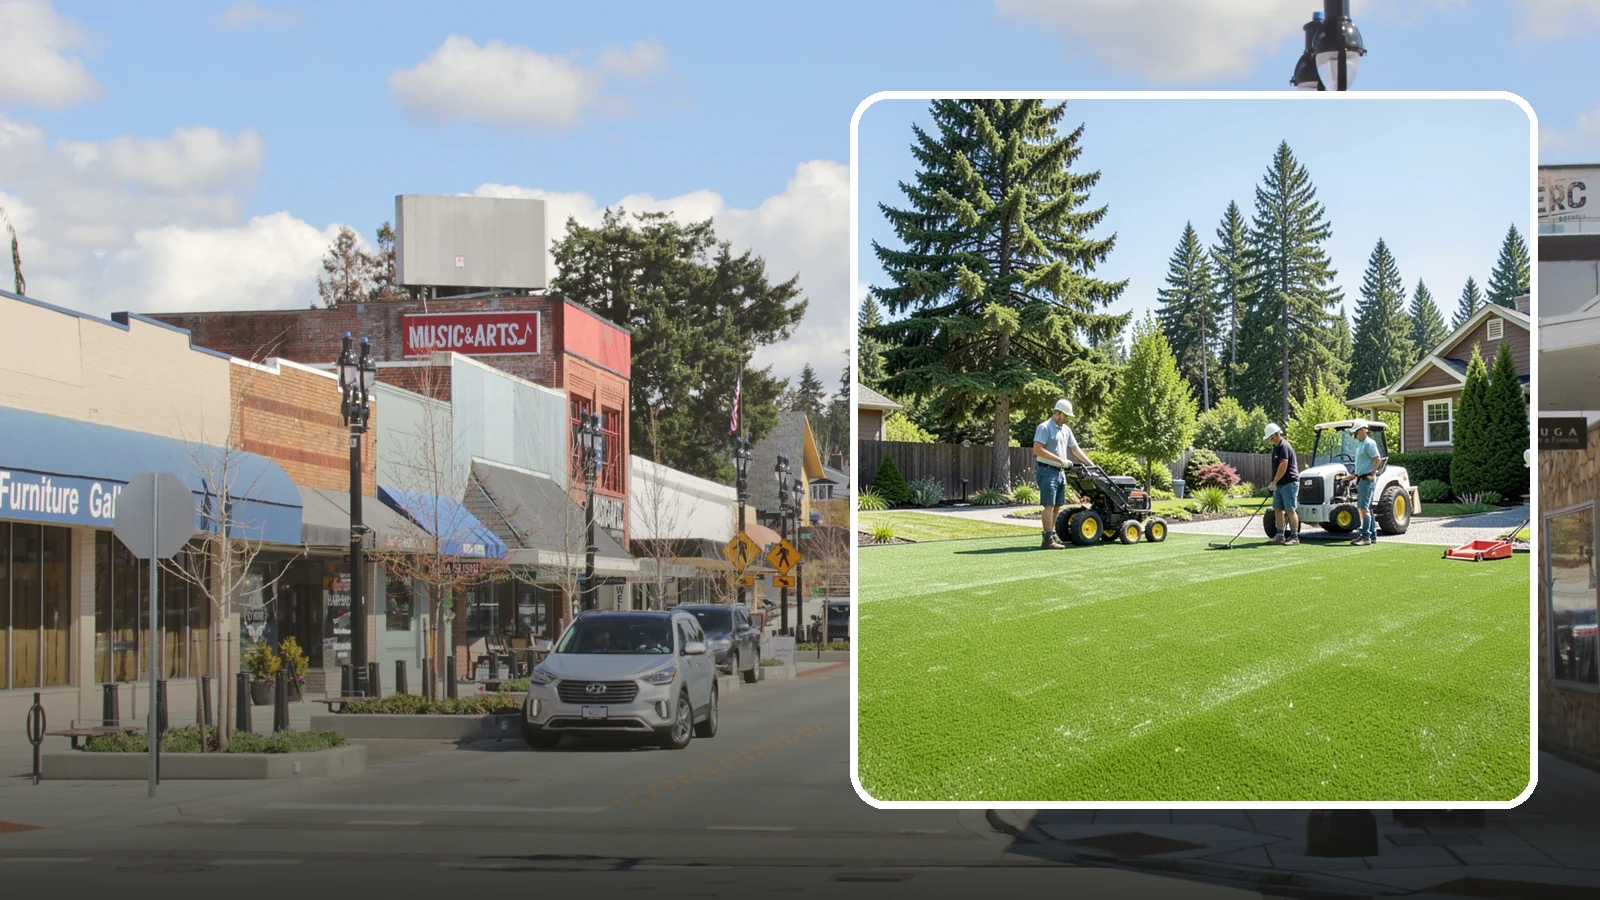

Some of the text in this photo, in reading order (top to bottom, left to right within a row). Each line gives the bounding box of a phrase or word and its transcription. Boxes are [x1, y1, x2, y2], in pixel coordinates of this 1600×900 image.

[408, 323, 520, 348] MUSIC&ARTS
[0, 471, 79, 515] Furniture
[453, 563, 479, 574] SUSHI
